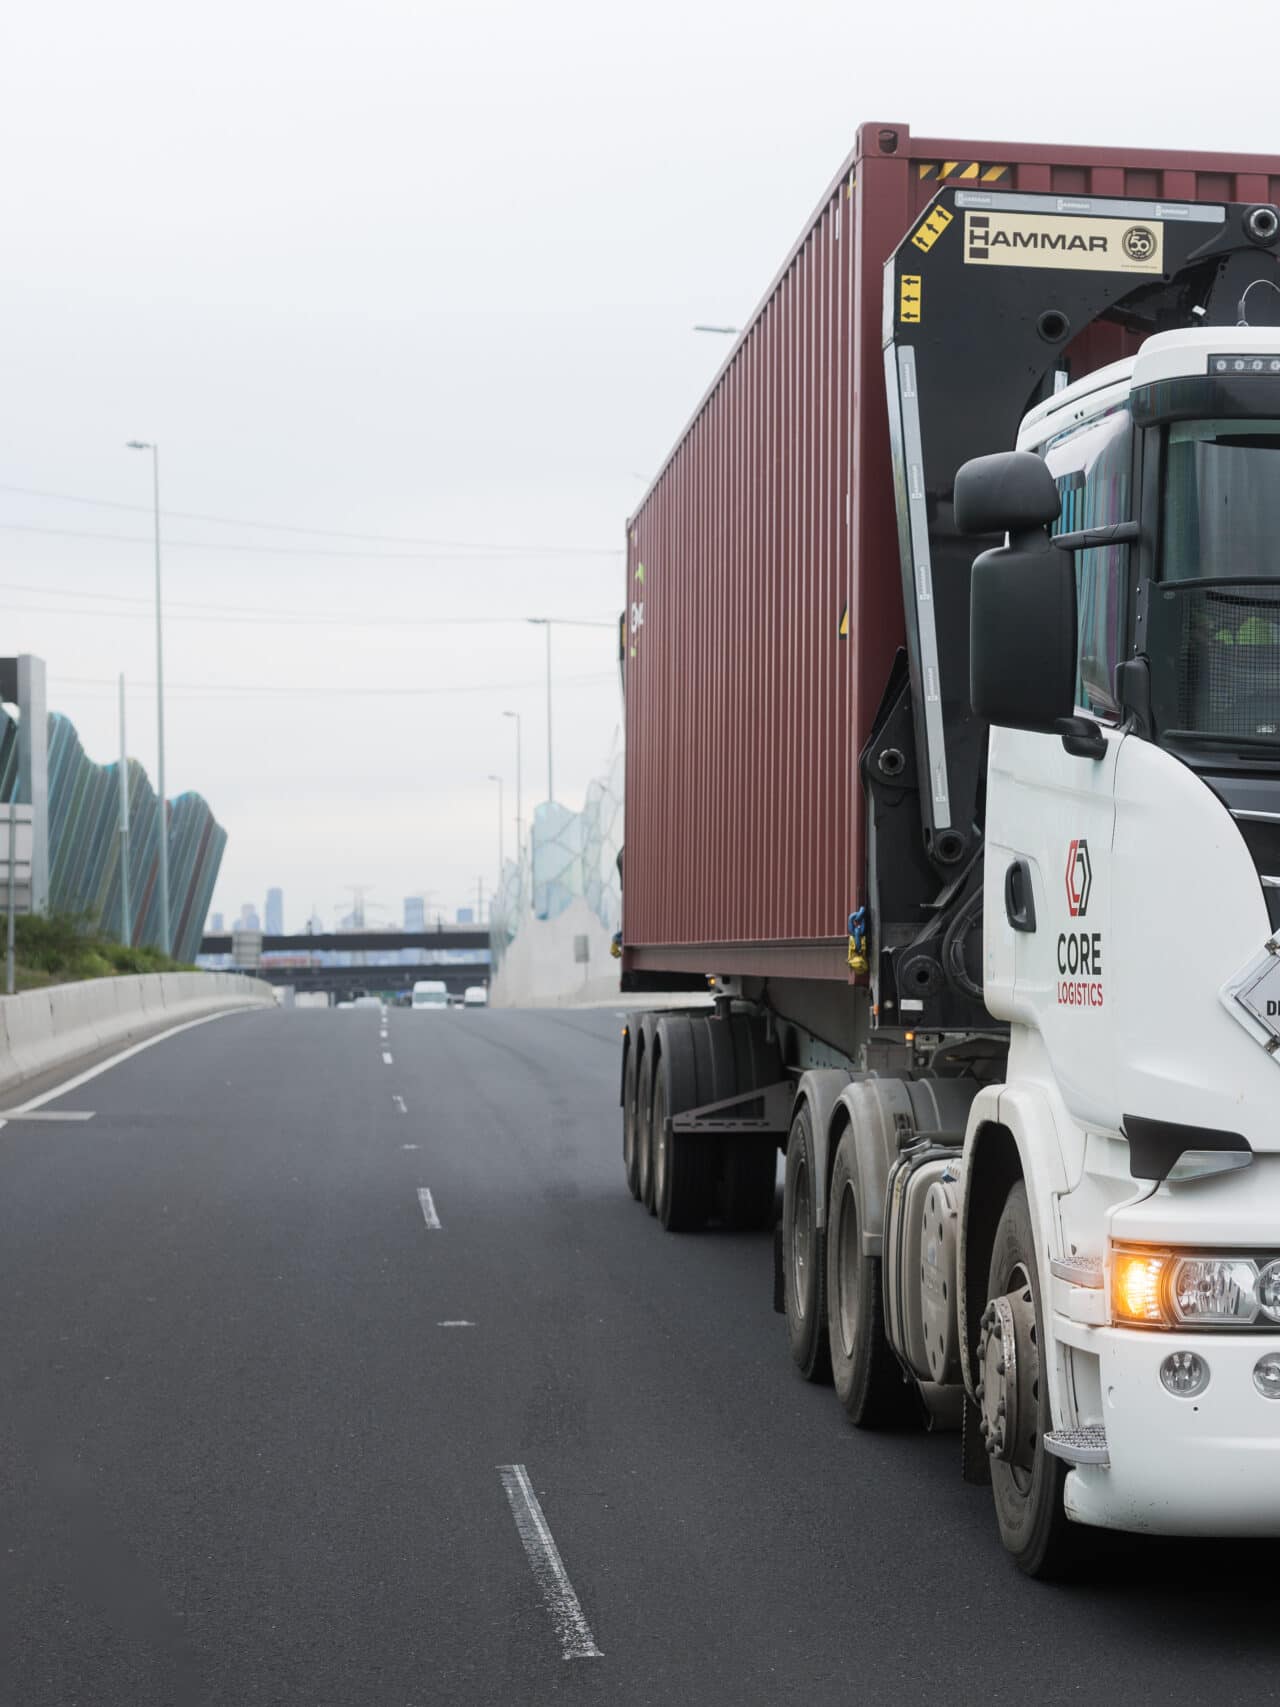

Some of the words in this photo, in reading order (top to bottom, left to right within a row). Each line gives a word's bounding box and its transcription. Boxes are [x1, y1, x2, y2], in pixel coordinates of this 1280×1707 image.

[968, 228, 1108, 252] HAMMAR
[1057, 932, 1102, 975] CORE
[1057, 981, 1104, 1007] LOGISTICS
